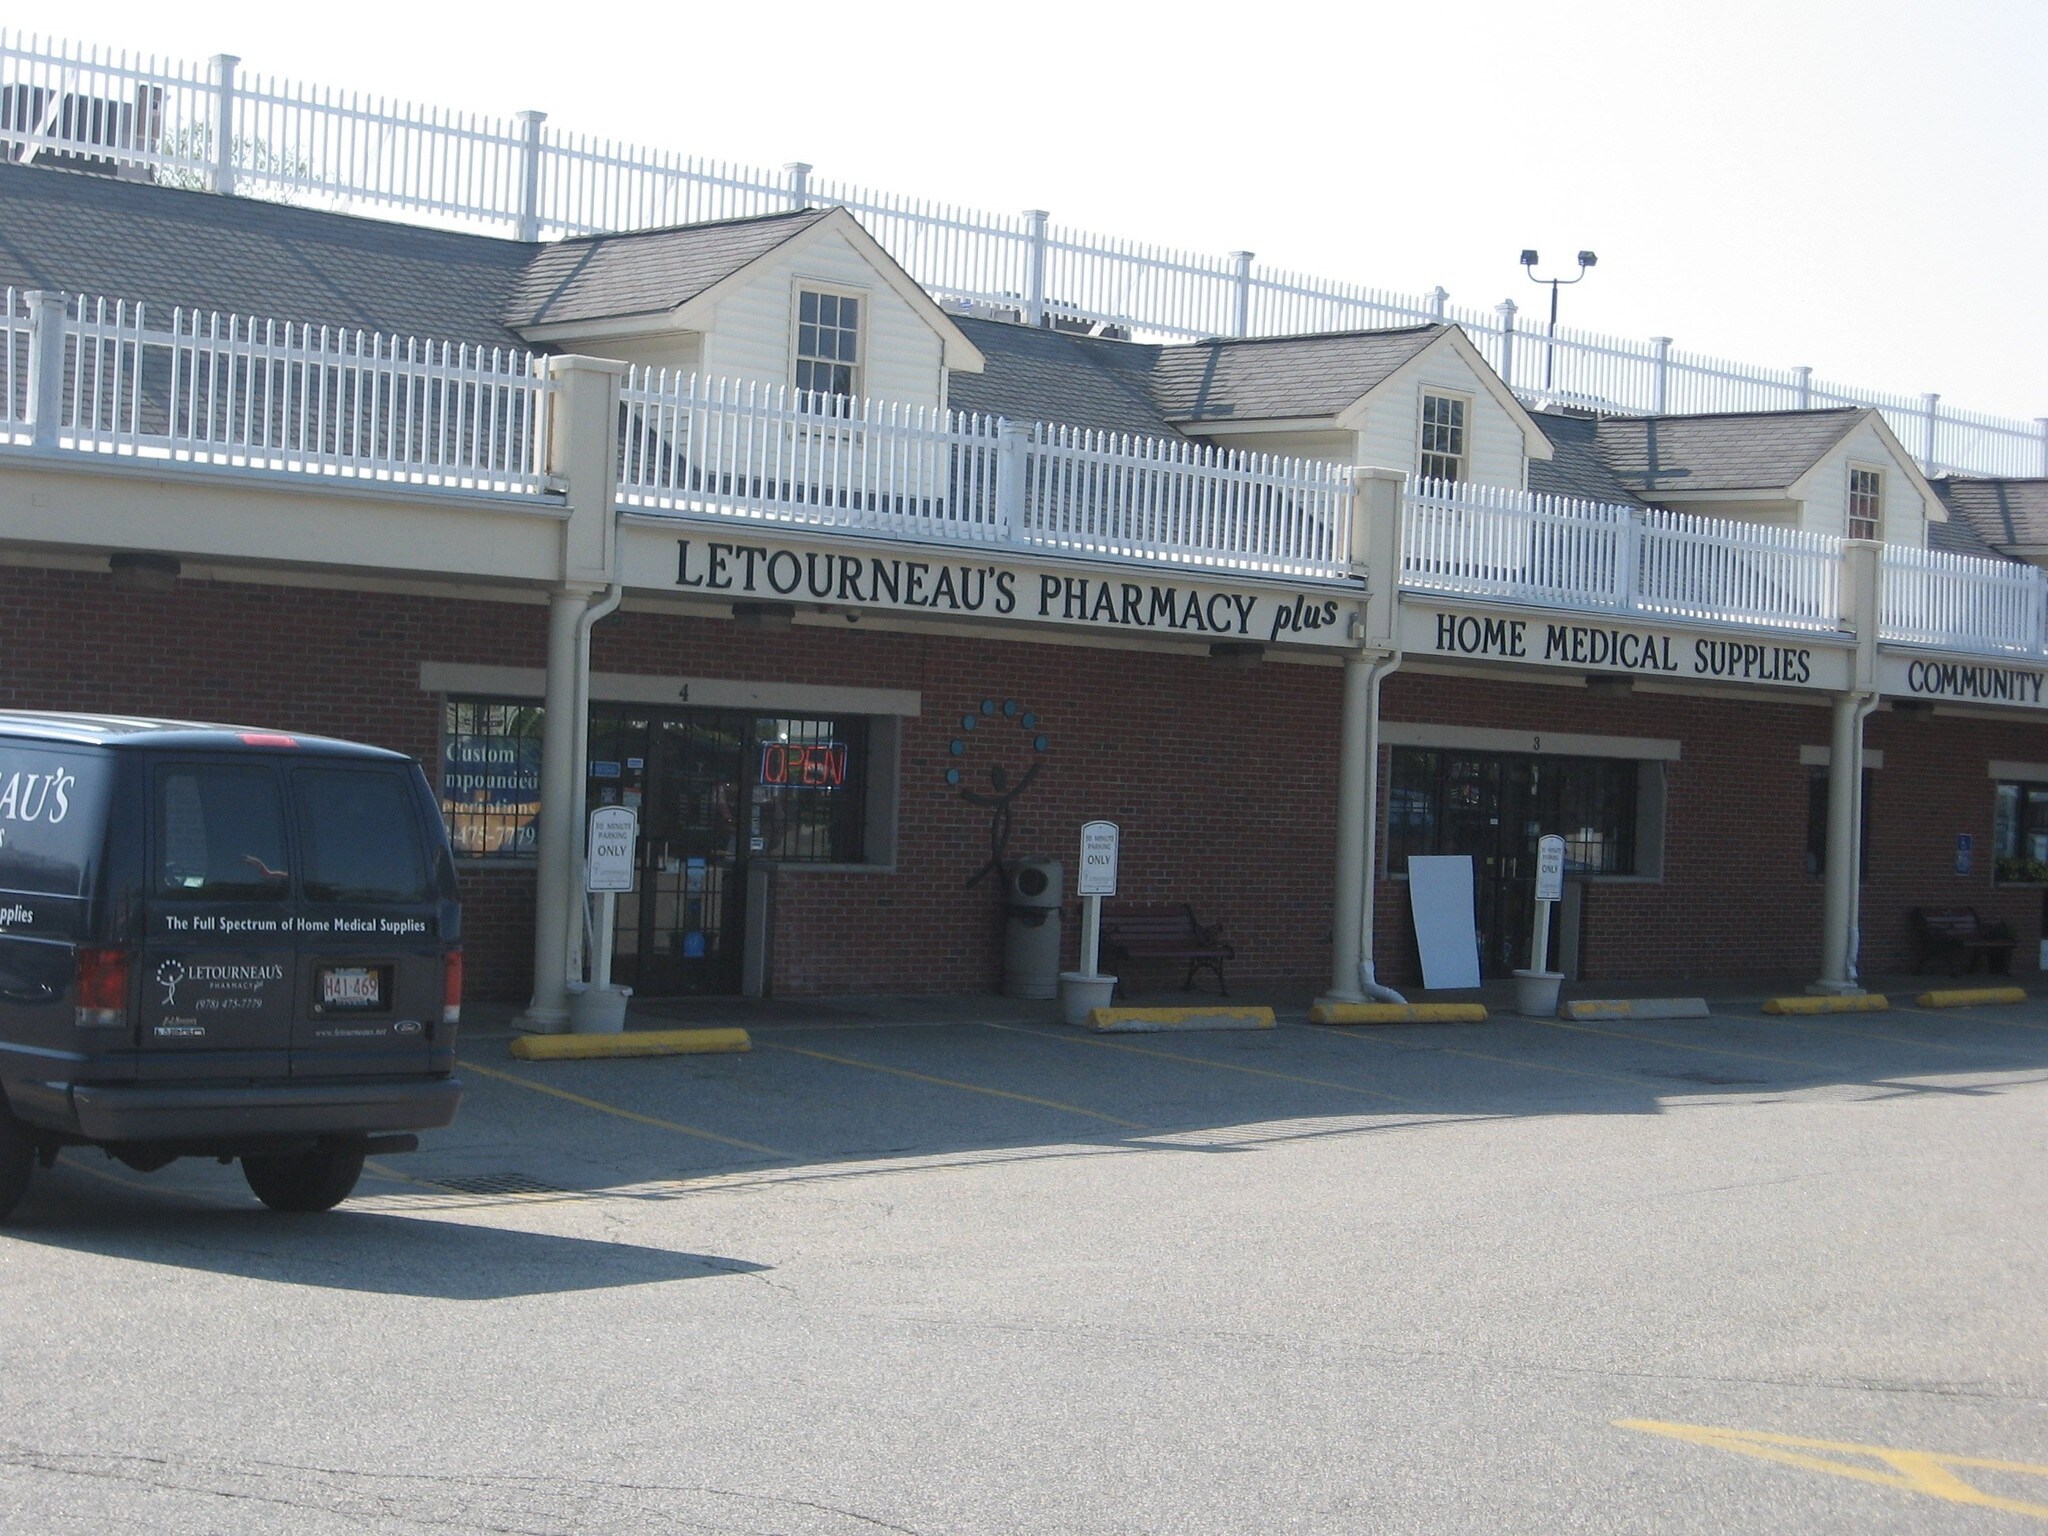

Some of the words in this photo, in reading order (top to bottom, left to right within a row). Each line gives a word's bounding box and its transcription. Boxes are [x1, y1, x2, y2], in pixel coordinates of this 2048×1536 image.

[675, 539, 1016, 614] LETOURNEAU'S
[1037, 573, 1258, 634] PHARMACY
[1269, 594, 1339, 643] plus
[1435, 613, 1527, 658] HOME
[1544, 624, 1678, 671] MEDICAL
[1694, 638, 1811, 684] SUPPLIES
[1908, 660, 2045, 702] COMMUNITY
[679, 683, 689, 702] 4
[445, 742, 515, 764] Custom
[1533, 736, 1540, 751] 3
[764, 743, 844, 785] OPEN
[0, 766, 75, 824] AU'S
[597, 845, 627, 857] ONLY
[1087, 855, 1111, 865] ONLY
[0, 903, 34, 926] pplies
[166, 916, 188, 930] The
[193, 917, 215, 930] Full
[219, 917, 277, 934] Spectrum
[281, 917, 294, 931] of
[297, 918, 330, 931] Home
[334, 918, 376, 932] Medical
[380, 919, 426, 935] Supplies
[188, 964, 283, 980] LETOURNEAU'S
